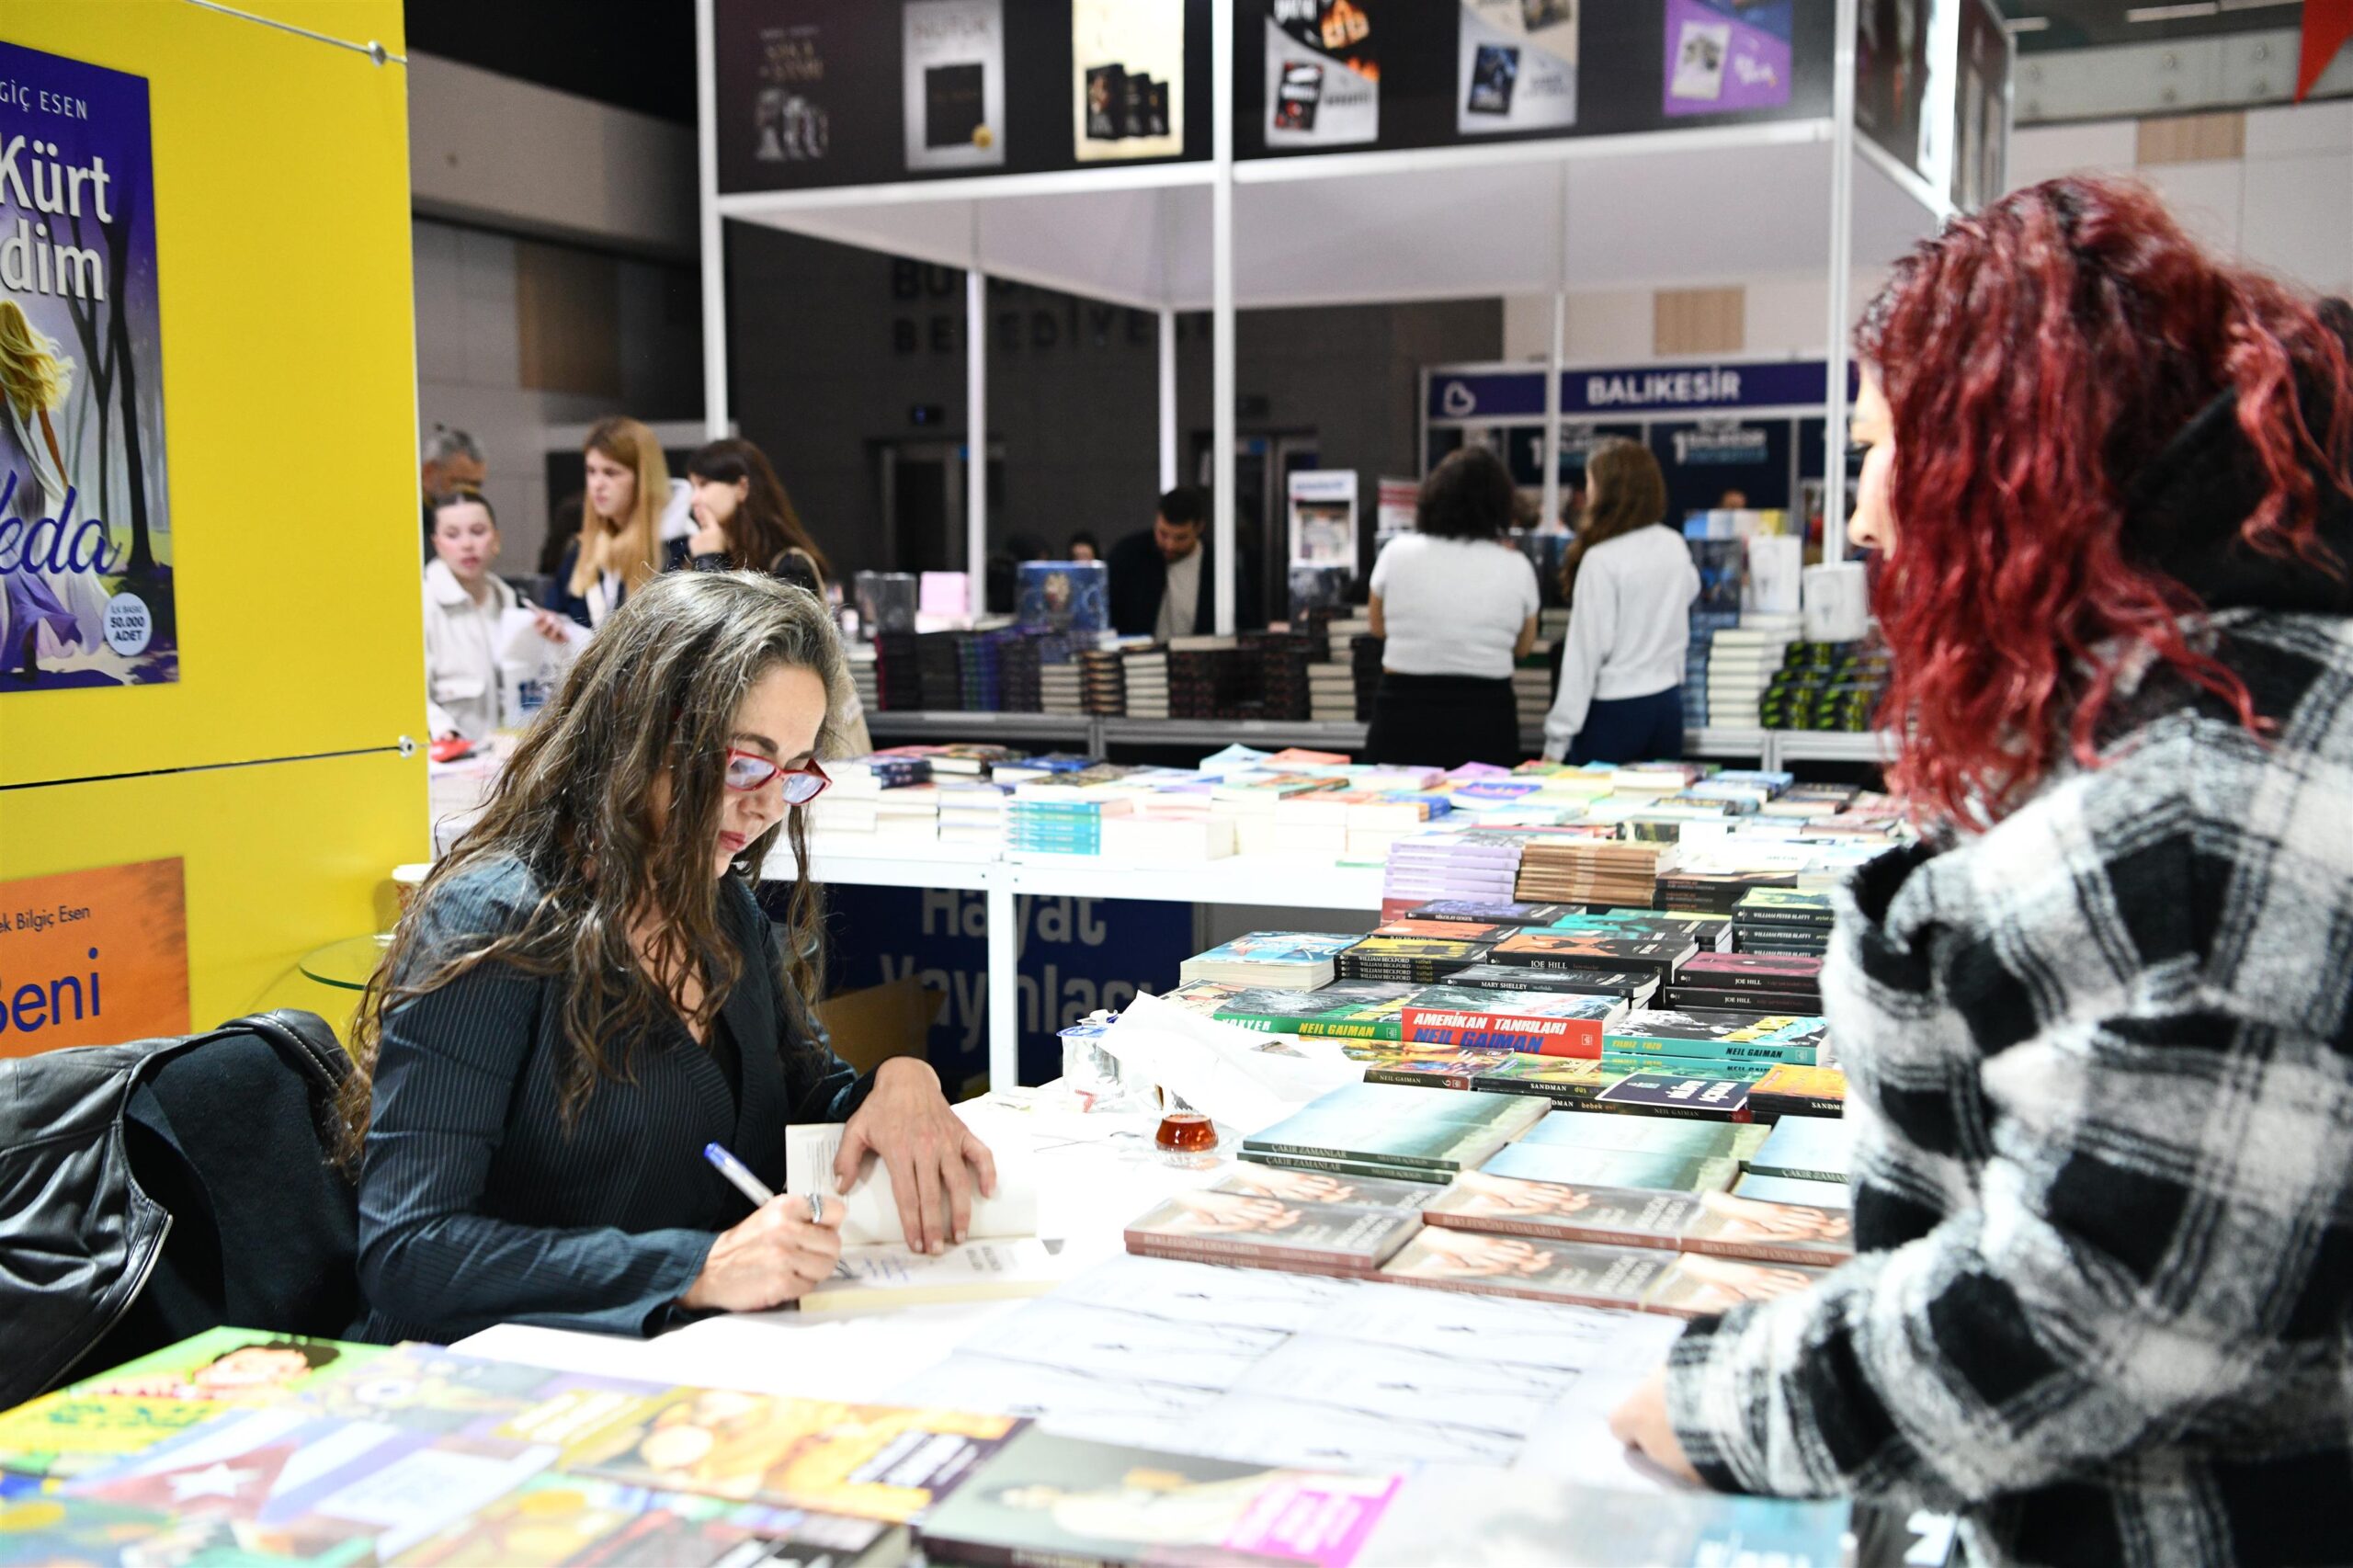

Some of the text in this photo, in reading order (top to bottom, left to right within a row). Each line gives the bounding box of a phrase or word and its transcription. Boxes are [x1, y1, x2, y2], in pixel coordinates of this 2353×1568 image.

[40, 90, 87, 119] ESEN
[0, 218, 104, 301] dim
[1587, 367, 1740, 404] BALIKESİR
[109, 617, 144, 629] 50.000
[113, 631, 142, 642] ADET
[16, 909, 54, 932] Bilgiç
[59, 905, 90, 923] Esen
[1530, 960, 1544, 969] JOE
[1548, 961, 1568, 970] HILL
[0, 947, 100, 1034] eni
[1298, 1022, 1324, 1034] NEIL
[1327, 1024, 1376, 1037] GAIMAN
[1414, 1012, 1568, 1035] AMERİKAN TANRILARI
[1413, 1028, 1544, 1053] NEIL GAIMAN
[1725, 1047, 1745, 1056] NEIL
[1746, 1048, 1783, 1058] GAIMAN
[1529, 1083, 1567, 1092] SANDMAN
[1581, 1101, 1603, 1110] bebek
[1671, 1109, 1699, 1118] GAIMAN
[1271, 1143, 1299, 1154] ÇAKIR
[1300, 1146, 1347, 1159] ZAMANLAR
[1294, 1158, 1342, 1172] ZAMANLAR
